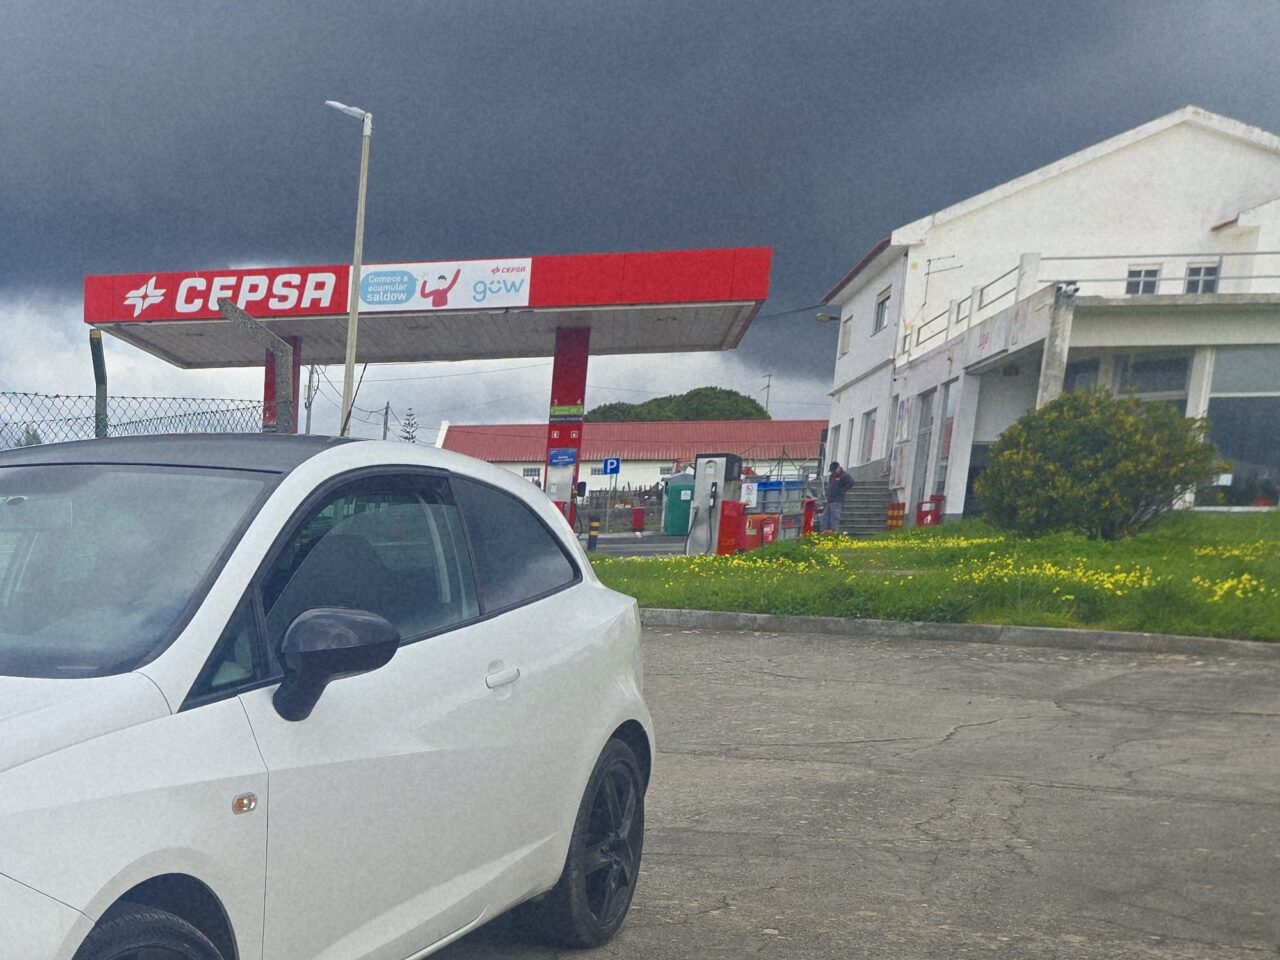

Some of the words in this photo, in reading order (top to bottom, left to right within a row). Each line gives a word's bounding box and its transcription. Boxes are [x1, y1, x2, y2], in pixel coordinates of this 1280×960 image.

[175, 272, 336, 313] CEPSA
[367, 283, 408, 292] acumular
[366, 291, 408, 302] saldow
[607, 459, 618, 473] P
